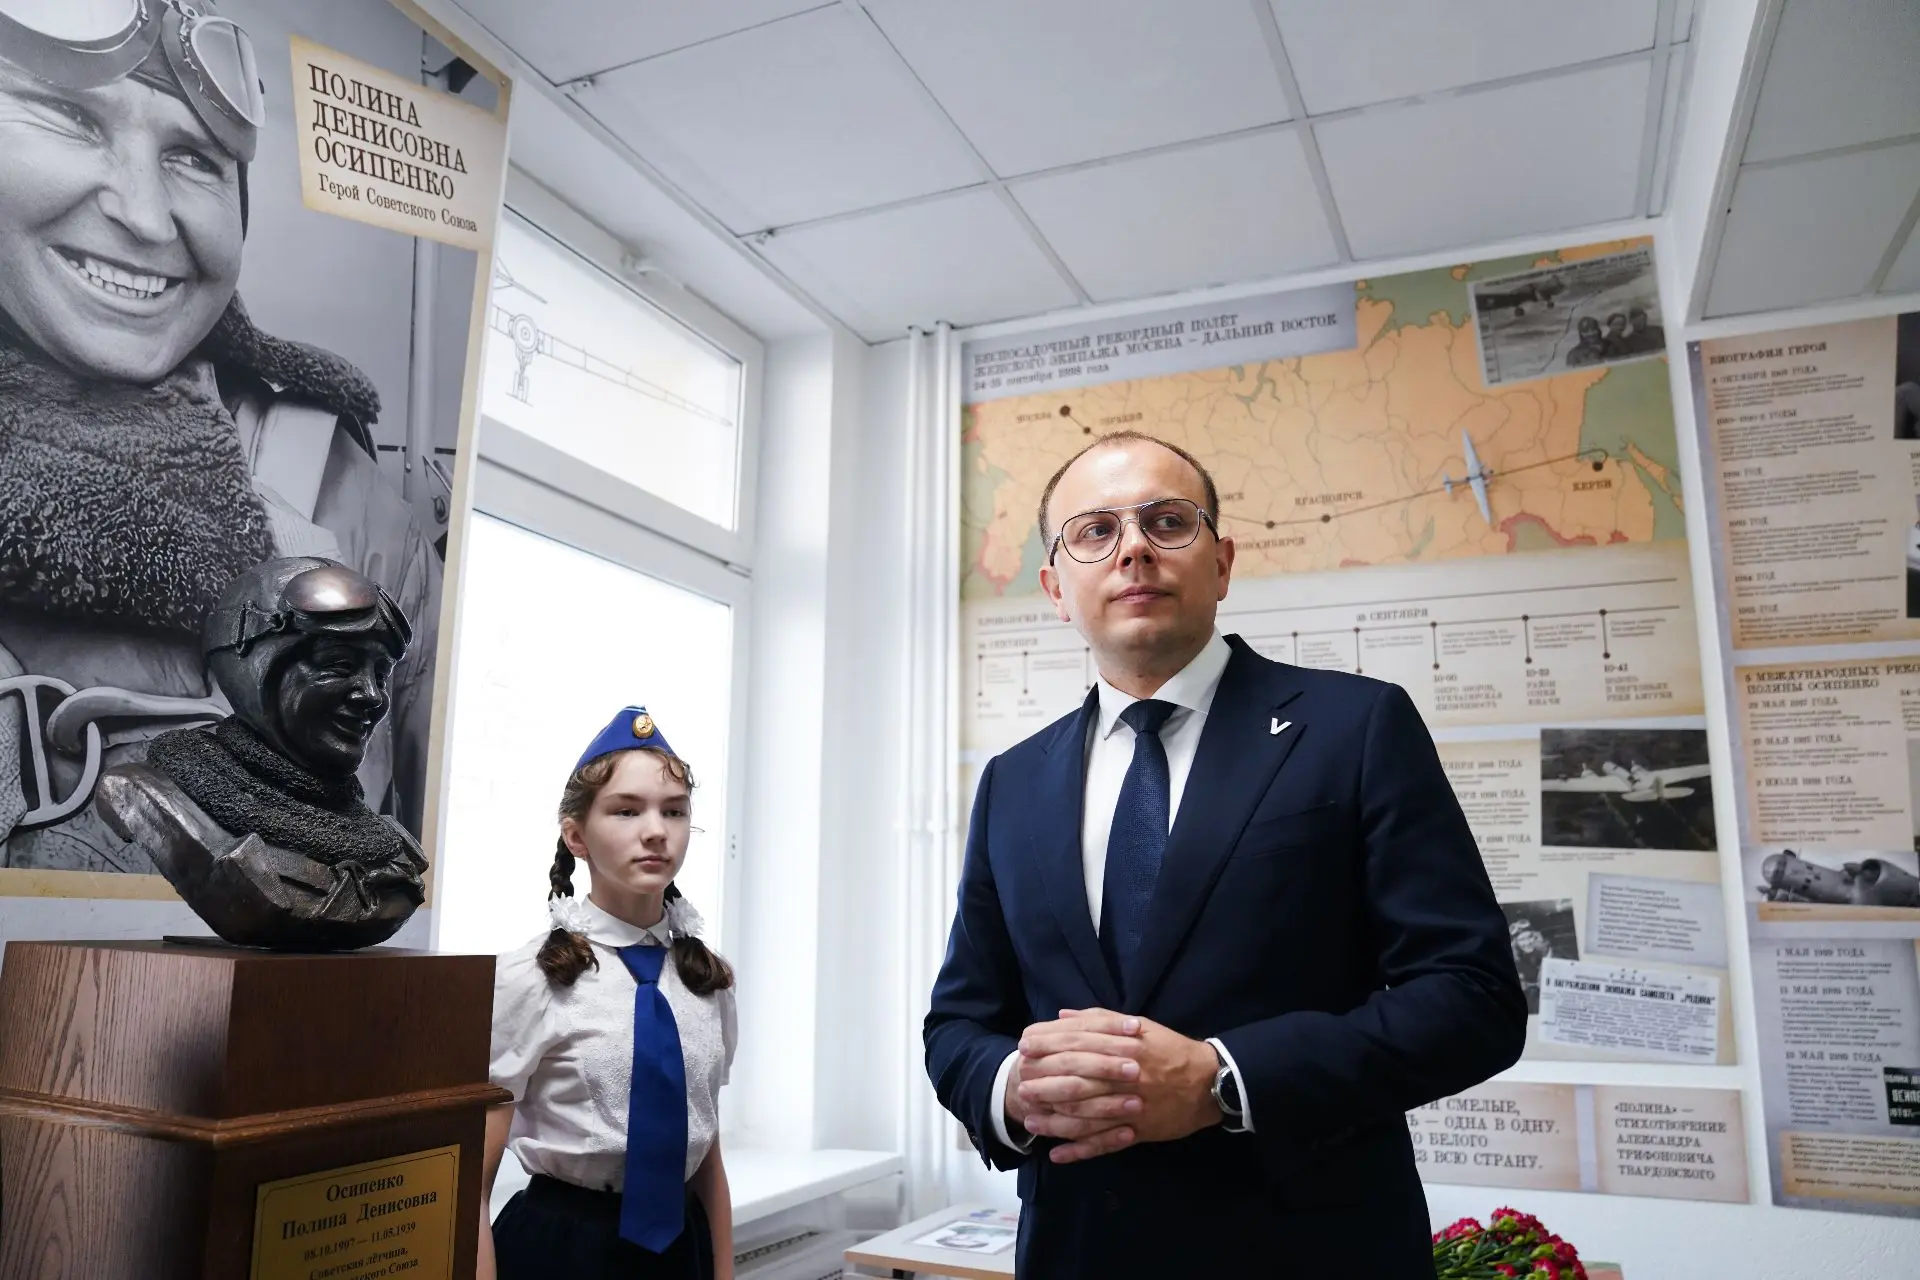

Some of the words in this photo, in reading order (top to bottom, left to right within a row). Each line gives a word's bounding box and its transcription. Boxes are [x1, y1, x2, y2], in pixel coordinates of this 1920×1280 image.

[307, 64, 422, 128] ПОЛИНА
[312, 99, 468, 174] ДЕНИСОВНА
[315, 136, 454, 200] ОСИПЕНКО
[318, 173, 360, 201] Герой
[367, 187, 436, 222] Советского
[441, 208, 477, 232] Союза
[1097, 320, 1185, 346] РЕКОРДНЫЙ
[1191, 313, 1239, 332] ПОЛЁТ
[974, 358, 1045, 378] ЖЕНСКОГО
[1048, 346, 1119, 366] ЭКИПАЖА
[1126, 337, 1182, 355] МОСКВА
[1202, 320, 1274, 346] ДАЛЬНИЙ
[1280, 313, 1337, 332] ВОСТОК
[1710, 348, 1783, 365] БИОГРАФИЯ
[1788, 342, 1827, 356] ГЕРОЯ
[1573, 479, 1612, 492] КЕРБИ
[1294, 490, 1362, 506] КРАСНОЯРСК
[1370, 607, 1428, 621] СЕНТЯБРЯ
[1756, 665, 1880, 682] МЕЖДУНАРОДНЫХ
[1747, 681, 1803, 695] ПОЛИНЫ
[1808, 678, 1880, 693] ОСИПЕНКО
[1761, 700, 1786, 709] МАЯ
[1812, 696, 1839, 707] ГОДА
[1815, 733, 1843, 744] ГОДА
[1784, 947, 1810, 957] МАЯ
[1837, 947, 1866, 958] ГОДА
[1793, 985, 1818, 996] МАЯ
[1845, 985, 1876, 997] ГОДА
[1800, 1051, 1825, 1061] МАЯ
[1853, 1051, 1882, 1063] ГОДА
[1446, 1098, 1521, 1116] СМЕЛЫЕ,
[1444, 1116, 1488, 1131] ОДНА
[1495, 1117, 1506, 1131] В
[1511, 1118, 1560, 1135] ОДНУ.
[1615, 1118, 1727, 1134] СТИХОТВОРЕНИЕ
[1430, 1132, 1488, 1148] БЕЛОГО
[1616, 1133, 1702, 1148] АЛЕКСАНДРА
[1434, 1150, 1467, 1165] ВСЮ
[1473, 1152, 1544, 1170] СТРАНУ.
[1617, 1148, 1715, 1165] ТРИФОНОВИЧА
[1618, 1164, 1716, 1181] ТВАРДОВСКОГО
[326, 1174, 404, 1202] Осипенко
[282, 1212, 347, 1240] Полина
[356, 1191, 437, 1224] Денисовна
[371, 1221, 417, 1244] 11.05.1939
[388, 1258, 419, 1274] Союза
